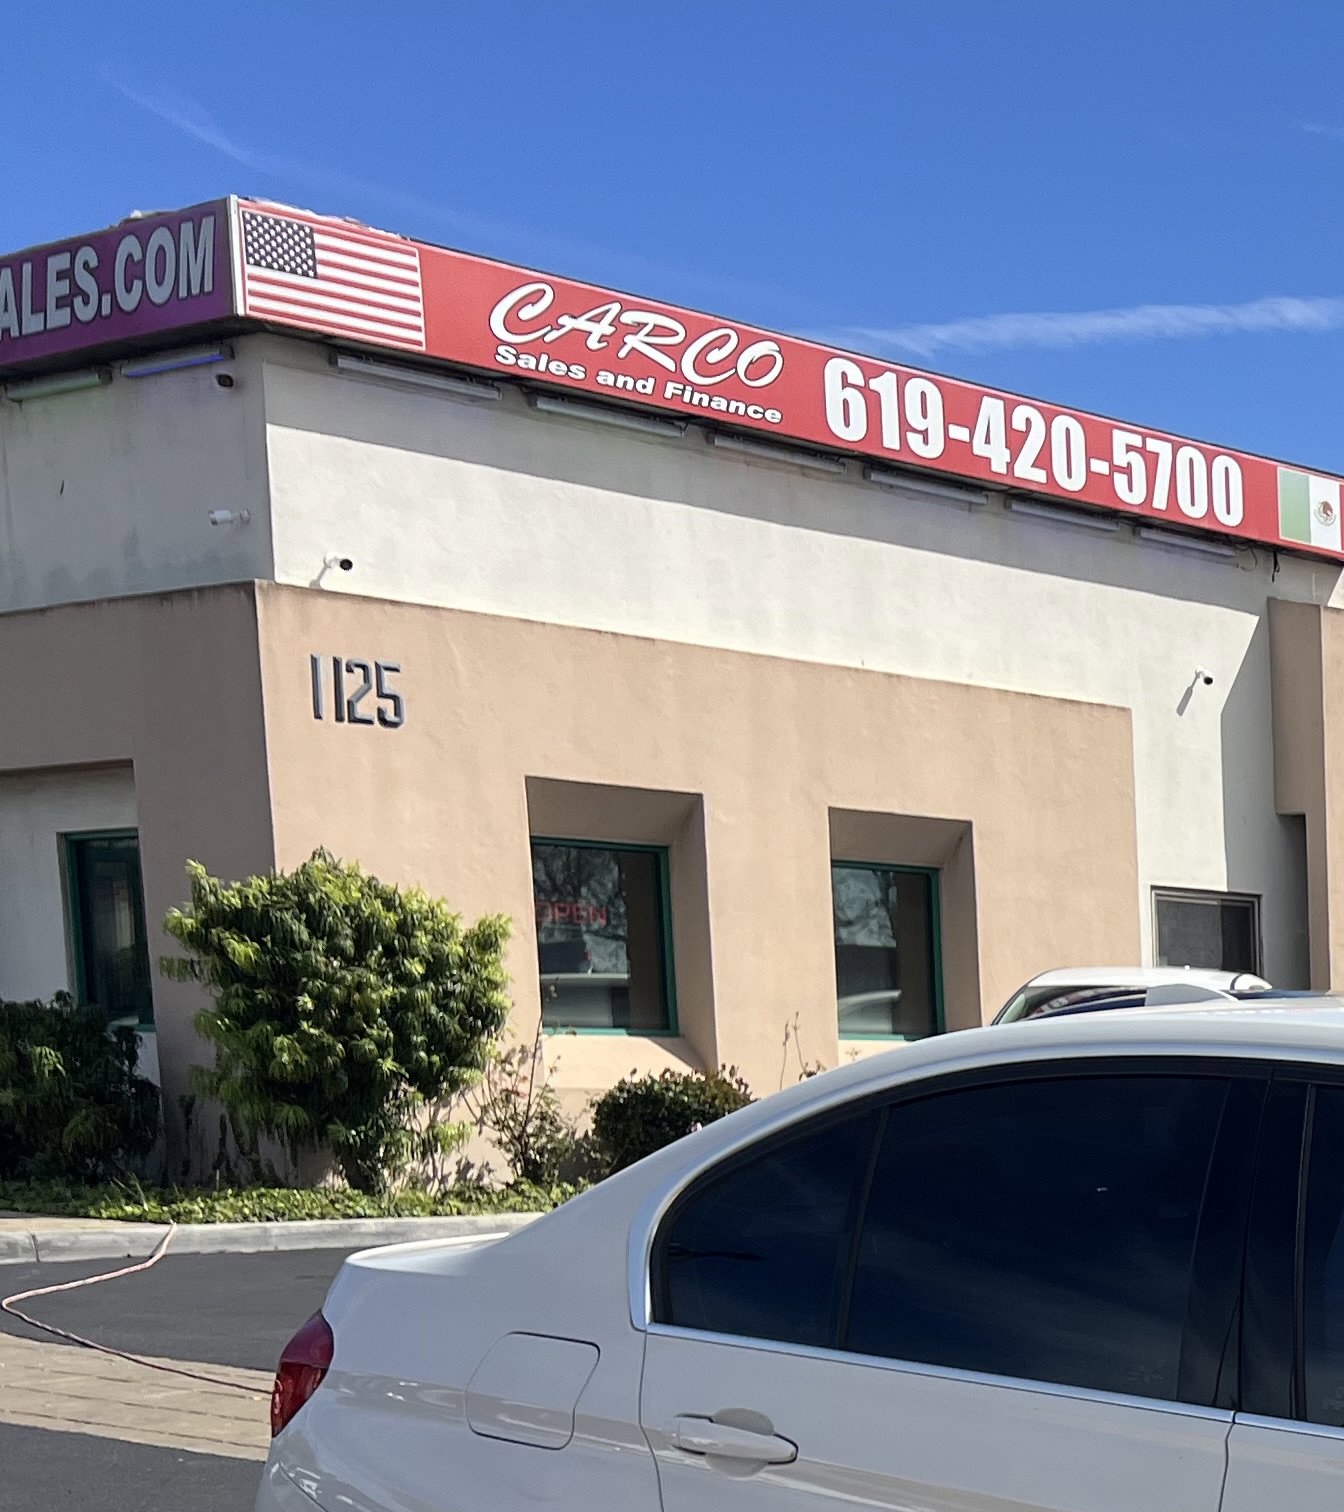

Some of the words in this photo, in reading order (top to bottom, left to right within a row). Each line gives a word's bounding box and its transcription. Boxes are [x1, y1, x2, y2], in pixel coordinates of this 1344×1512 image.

[0, 215, 215, 338] ALES.COM
[489, 282, 784, 387] CARCO
[495, 343, 587, 380] Sales
[596, 368, 656, 395] and
[663, 380, 783, 423] Finance
[823, 357, 1244, 527] 619-420-5700
[310, 654, 404, 728] 1125
